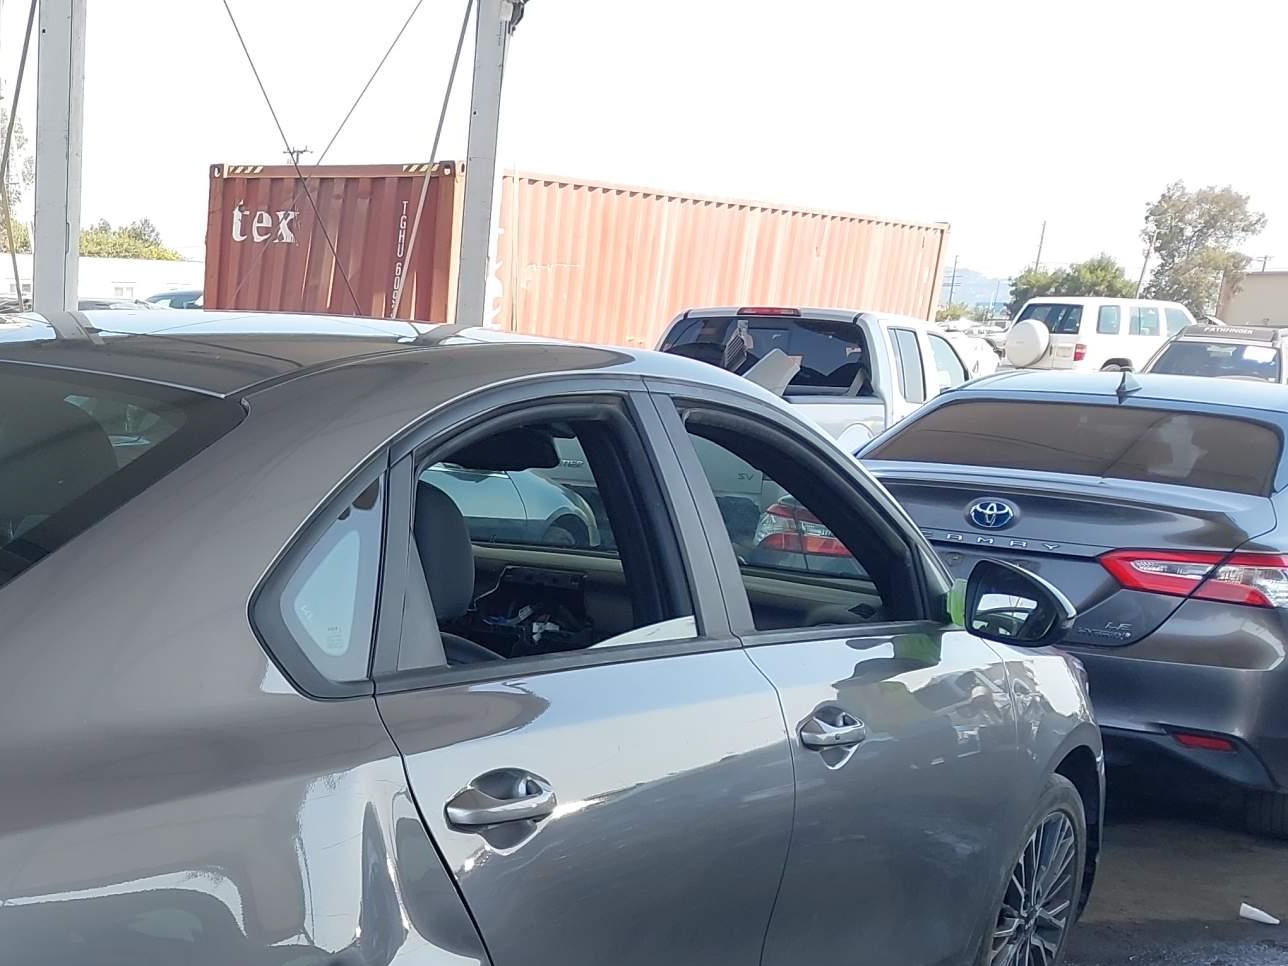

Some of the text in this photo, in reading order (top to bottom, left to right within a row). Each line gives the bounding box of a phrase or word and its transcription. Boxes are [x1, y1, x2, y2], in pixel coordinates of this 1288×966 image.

[232, 200, 300, 243] tex
[397, 200, 409, 258] TGHU
[1203, 327, 1254, 335] PATHFINDER
